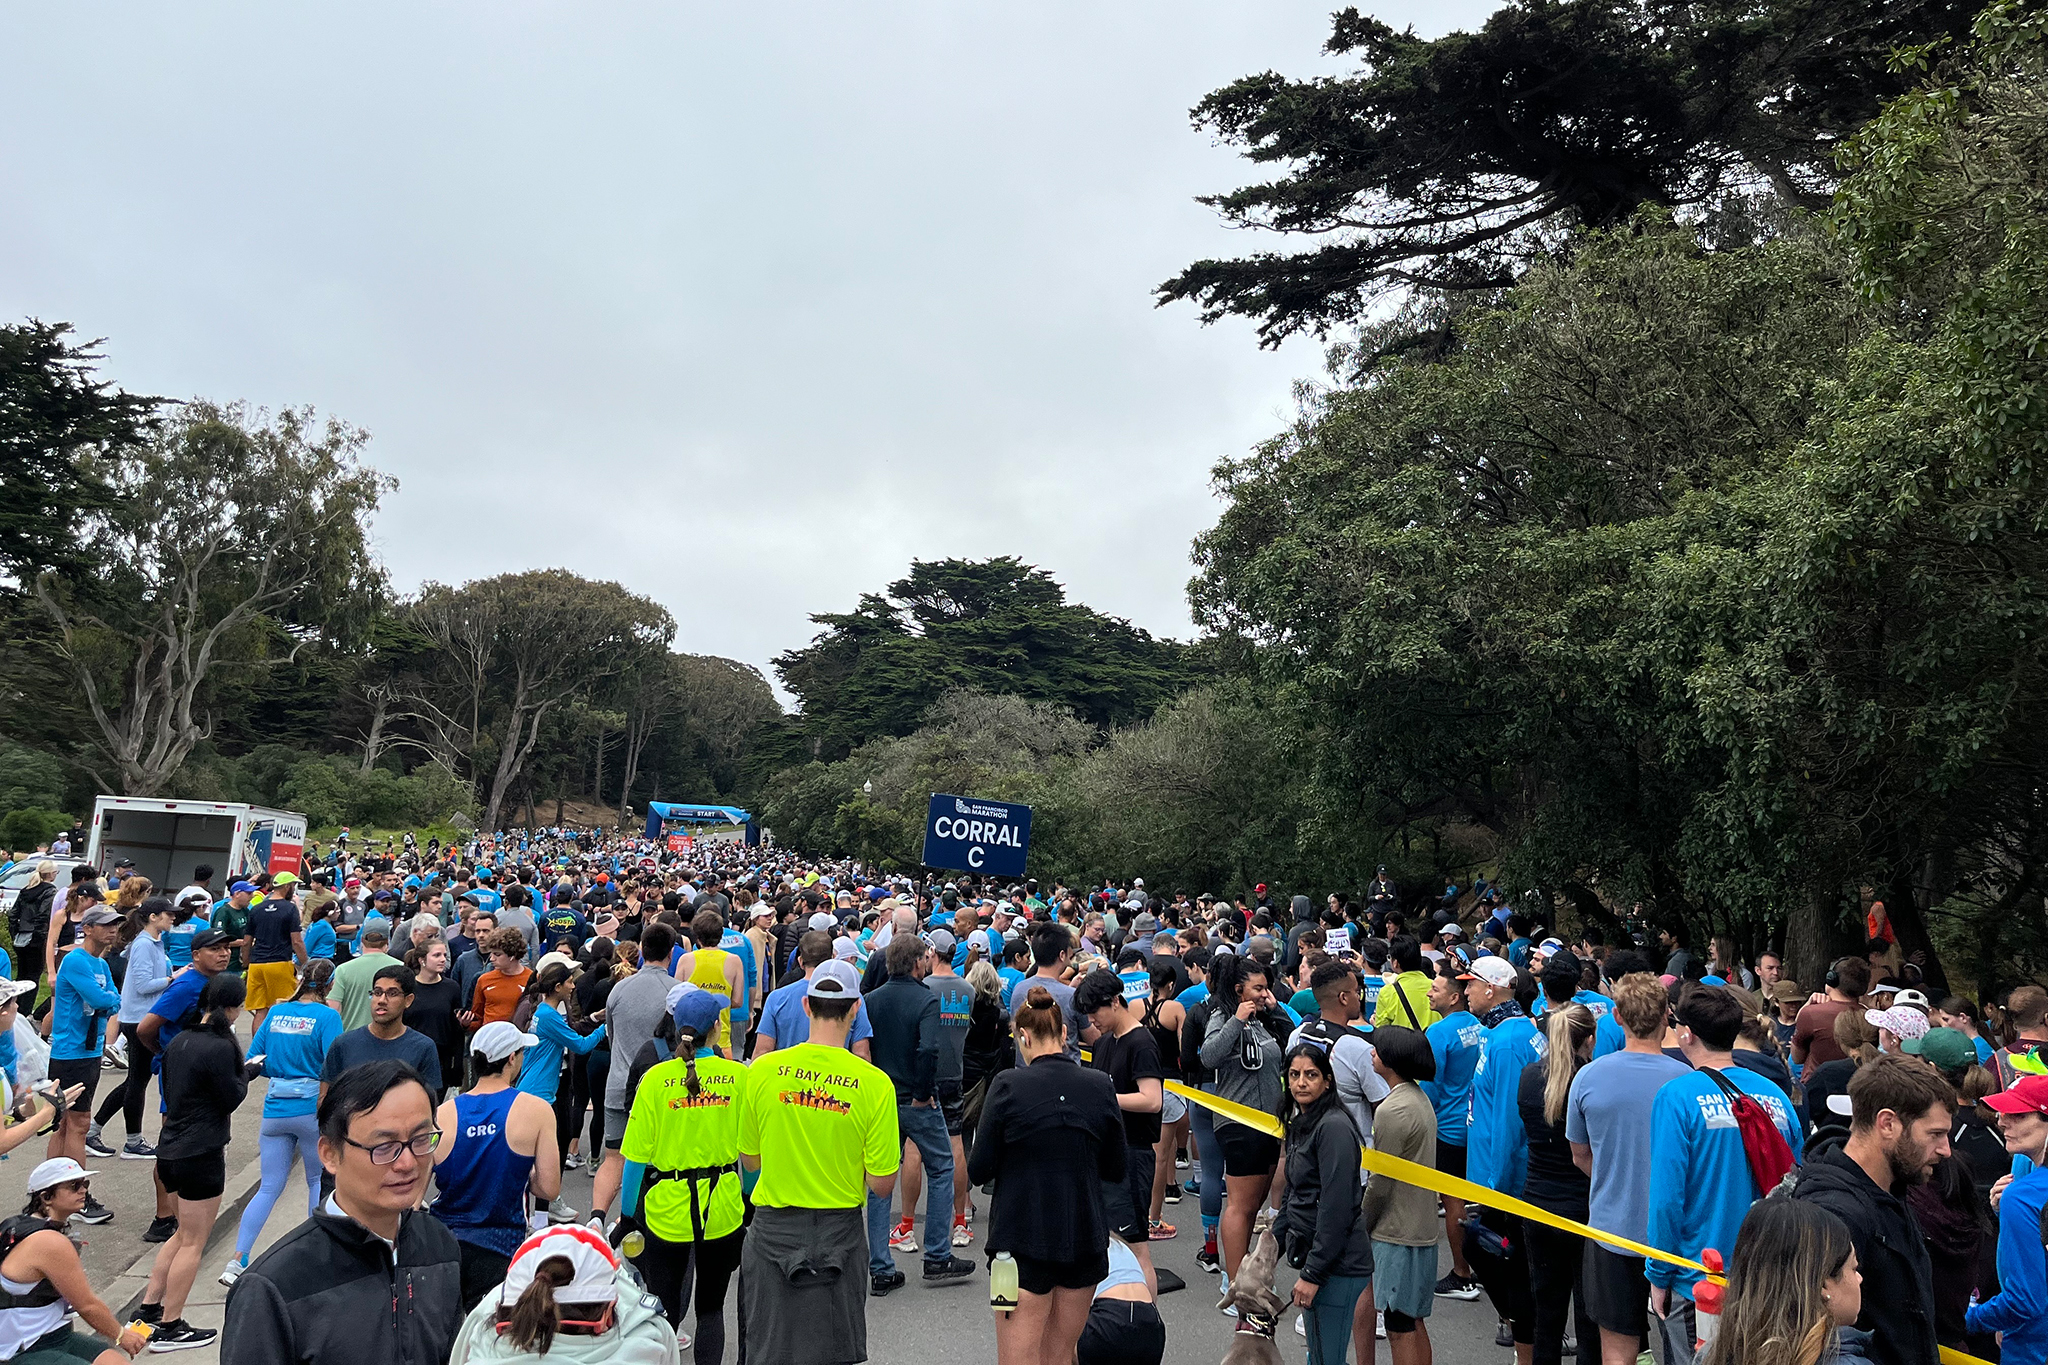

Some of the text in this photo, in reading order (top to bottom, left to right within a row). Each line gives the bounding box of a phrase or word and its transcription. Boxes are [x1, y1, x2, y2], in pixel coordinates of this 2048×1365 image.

[971, 808, 1008, 819] MARATHON
[982, 804, 1008, 814] FRANCISCO
[934, 816, 1022, 848] CORRAL
[967, 846, 985, 868] C
[700, 982, 727, 991] Achilles
[284, 1015, 317, 1024] FRANCISCO
[664, 1078, 677, 1087] SF
[705, 1075, 735, 1085] AREA
[777, 1065, 860, 1090] SF BAY AREA
[1696, 1093, 1723, 1105] SAN
[466, 1123, 497, 1138] CRC
